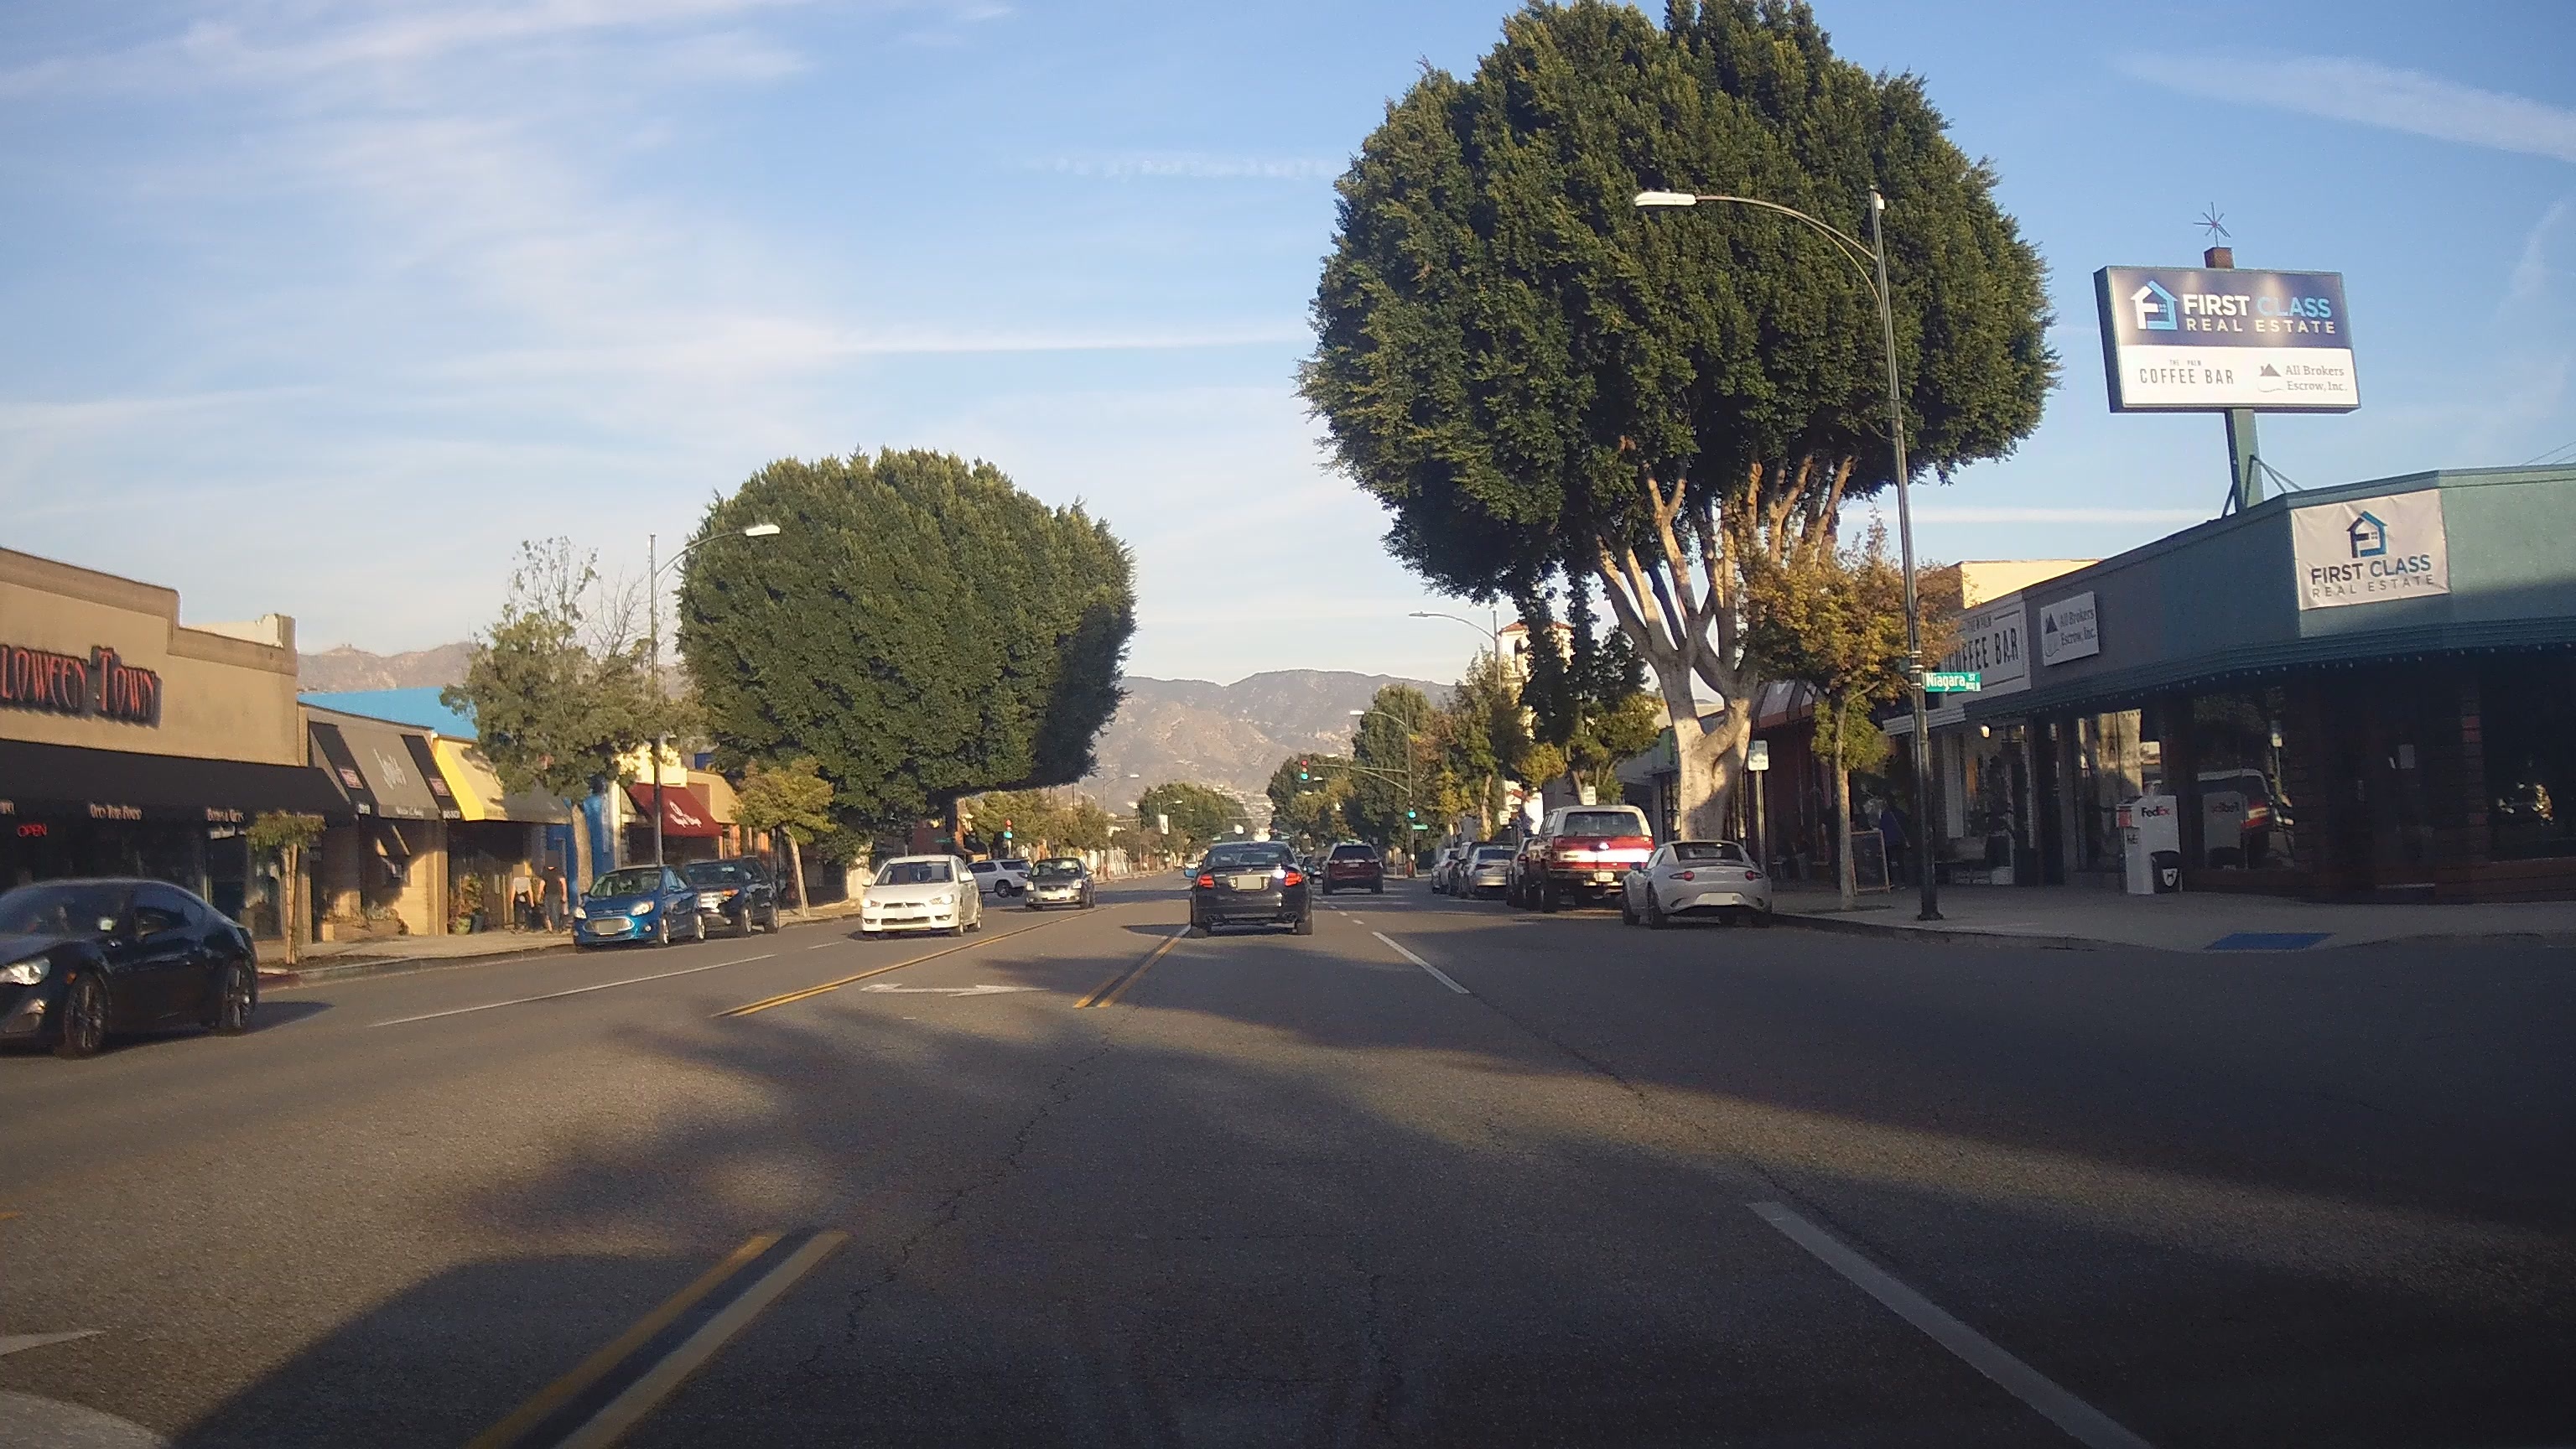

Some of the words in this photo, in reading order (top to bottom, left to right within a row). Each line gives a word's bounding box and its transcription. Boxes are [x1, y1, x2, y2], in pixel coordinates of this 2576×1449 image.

[2182, 294, 2251, 316] FIRST
[2257, 296, 2333, 318] CLASS
[2185, 318, 2244, 332] REAL
[2255, 319, 2336, 334] ESTATE
[2139, 368, 2196, 385] COFFEE
[2205, 369, 2234, 384] BAR
[2285, 365, 2301, 377] All
[2303, 366, 2345, 377] Brokers
[2328, 382, 2349, 392] Inc.
[2311, 563, 2364, 585] FIRST
[2370, 553, 2432, 578] CLASS
[2312, 586, 2358, 599] REAL
[2368, 574, 2434, 592] ESTATE
[2069, 608, 2095, 626] Brokers
[1994, 627, 2019, 665] BAR
[1925, 673, 1966, 692] Niagara
[2141, 805, 2170, 818] FedEx
